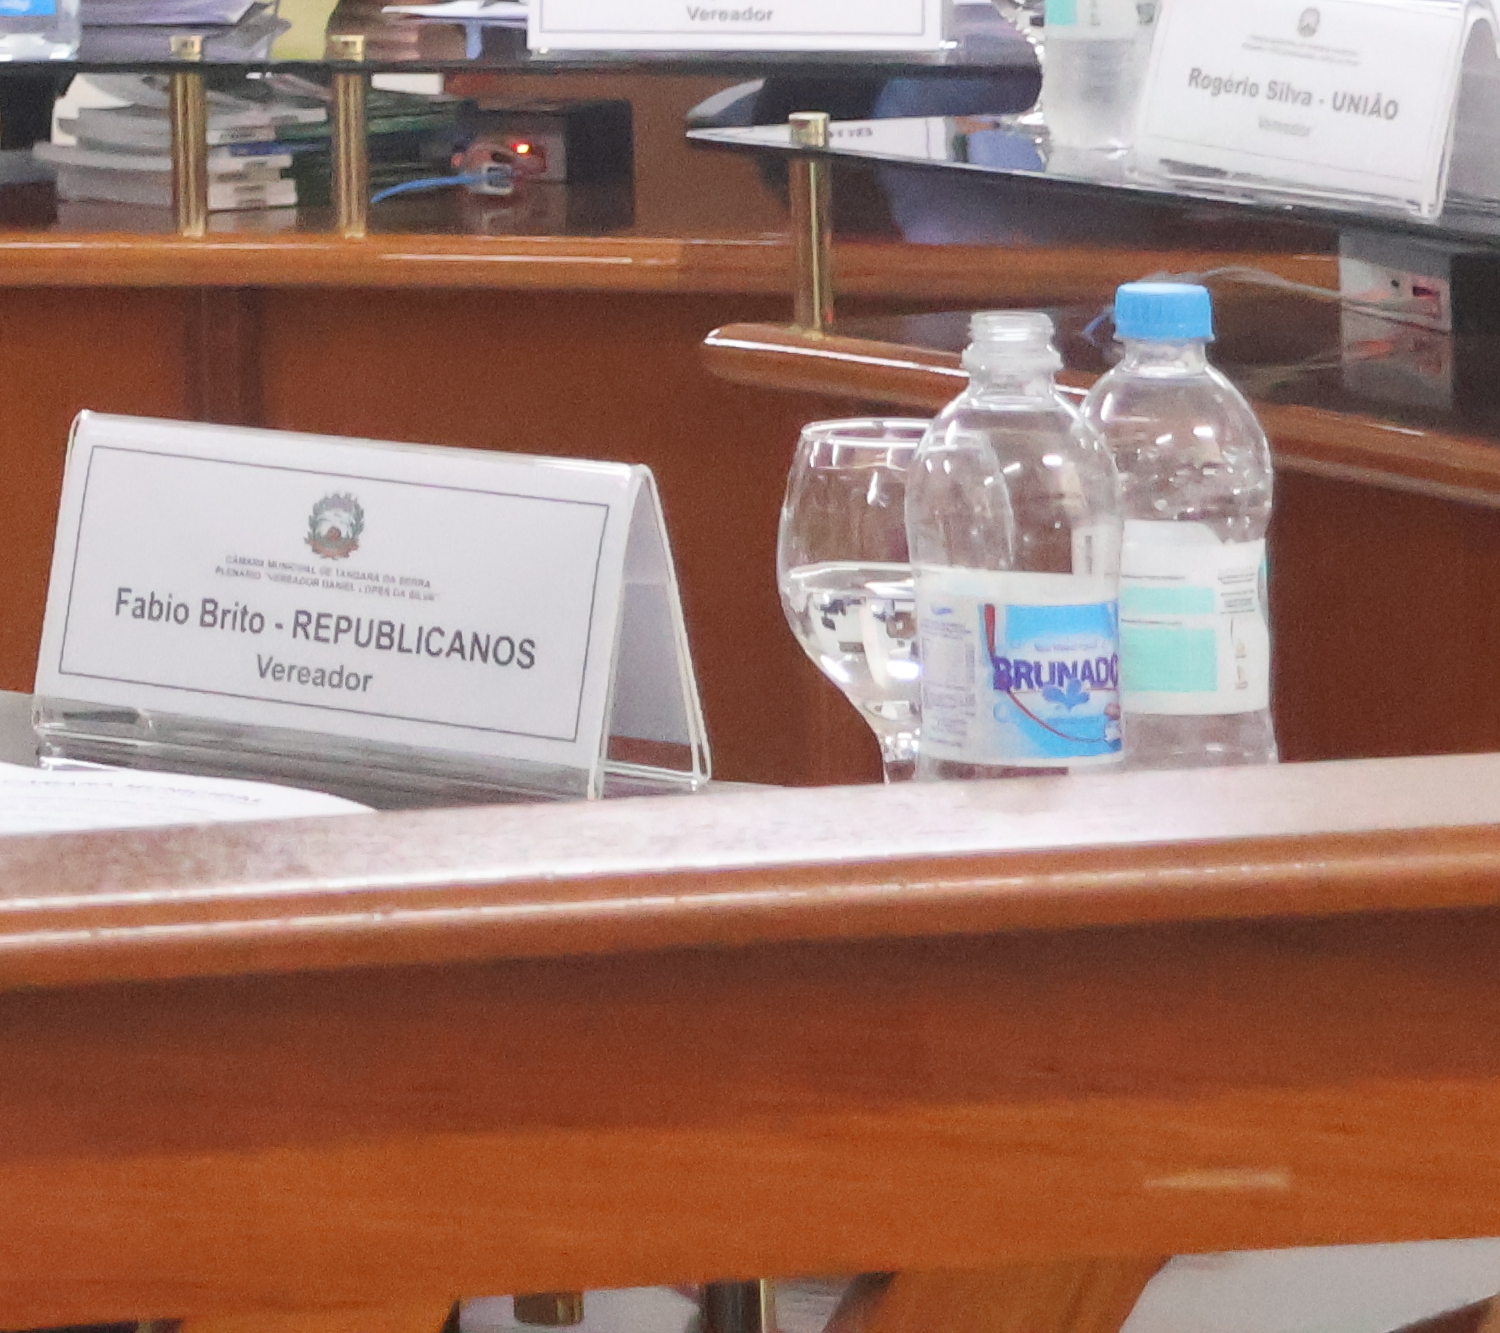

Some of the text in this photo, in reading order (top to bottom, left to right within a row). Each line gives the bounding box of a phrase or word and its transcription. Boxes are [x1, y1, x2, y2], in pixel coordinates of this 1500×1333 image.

[686, 5, 773, 21] Vereador
[1188, 67, 1259, 97] Rogério
[1266, 80, 1313, 106] Silva
[1332, 91, 1399, 120] UNIÃO
[114, 587, 190, 627] Fabio
[199, 598, 265, 635] Brito
[292, 610, 537, 670] REPUBLICANOS
[256, 654, 373, 694] Vereador
